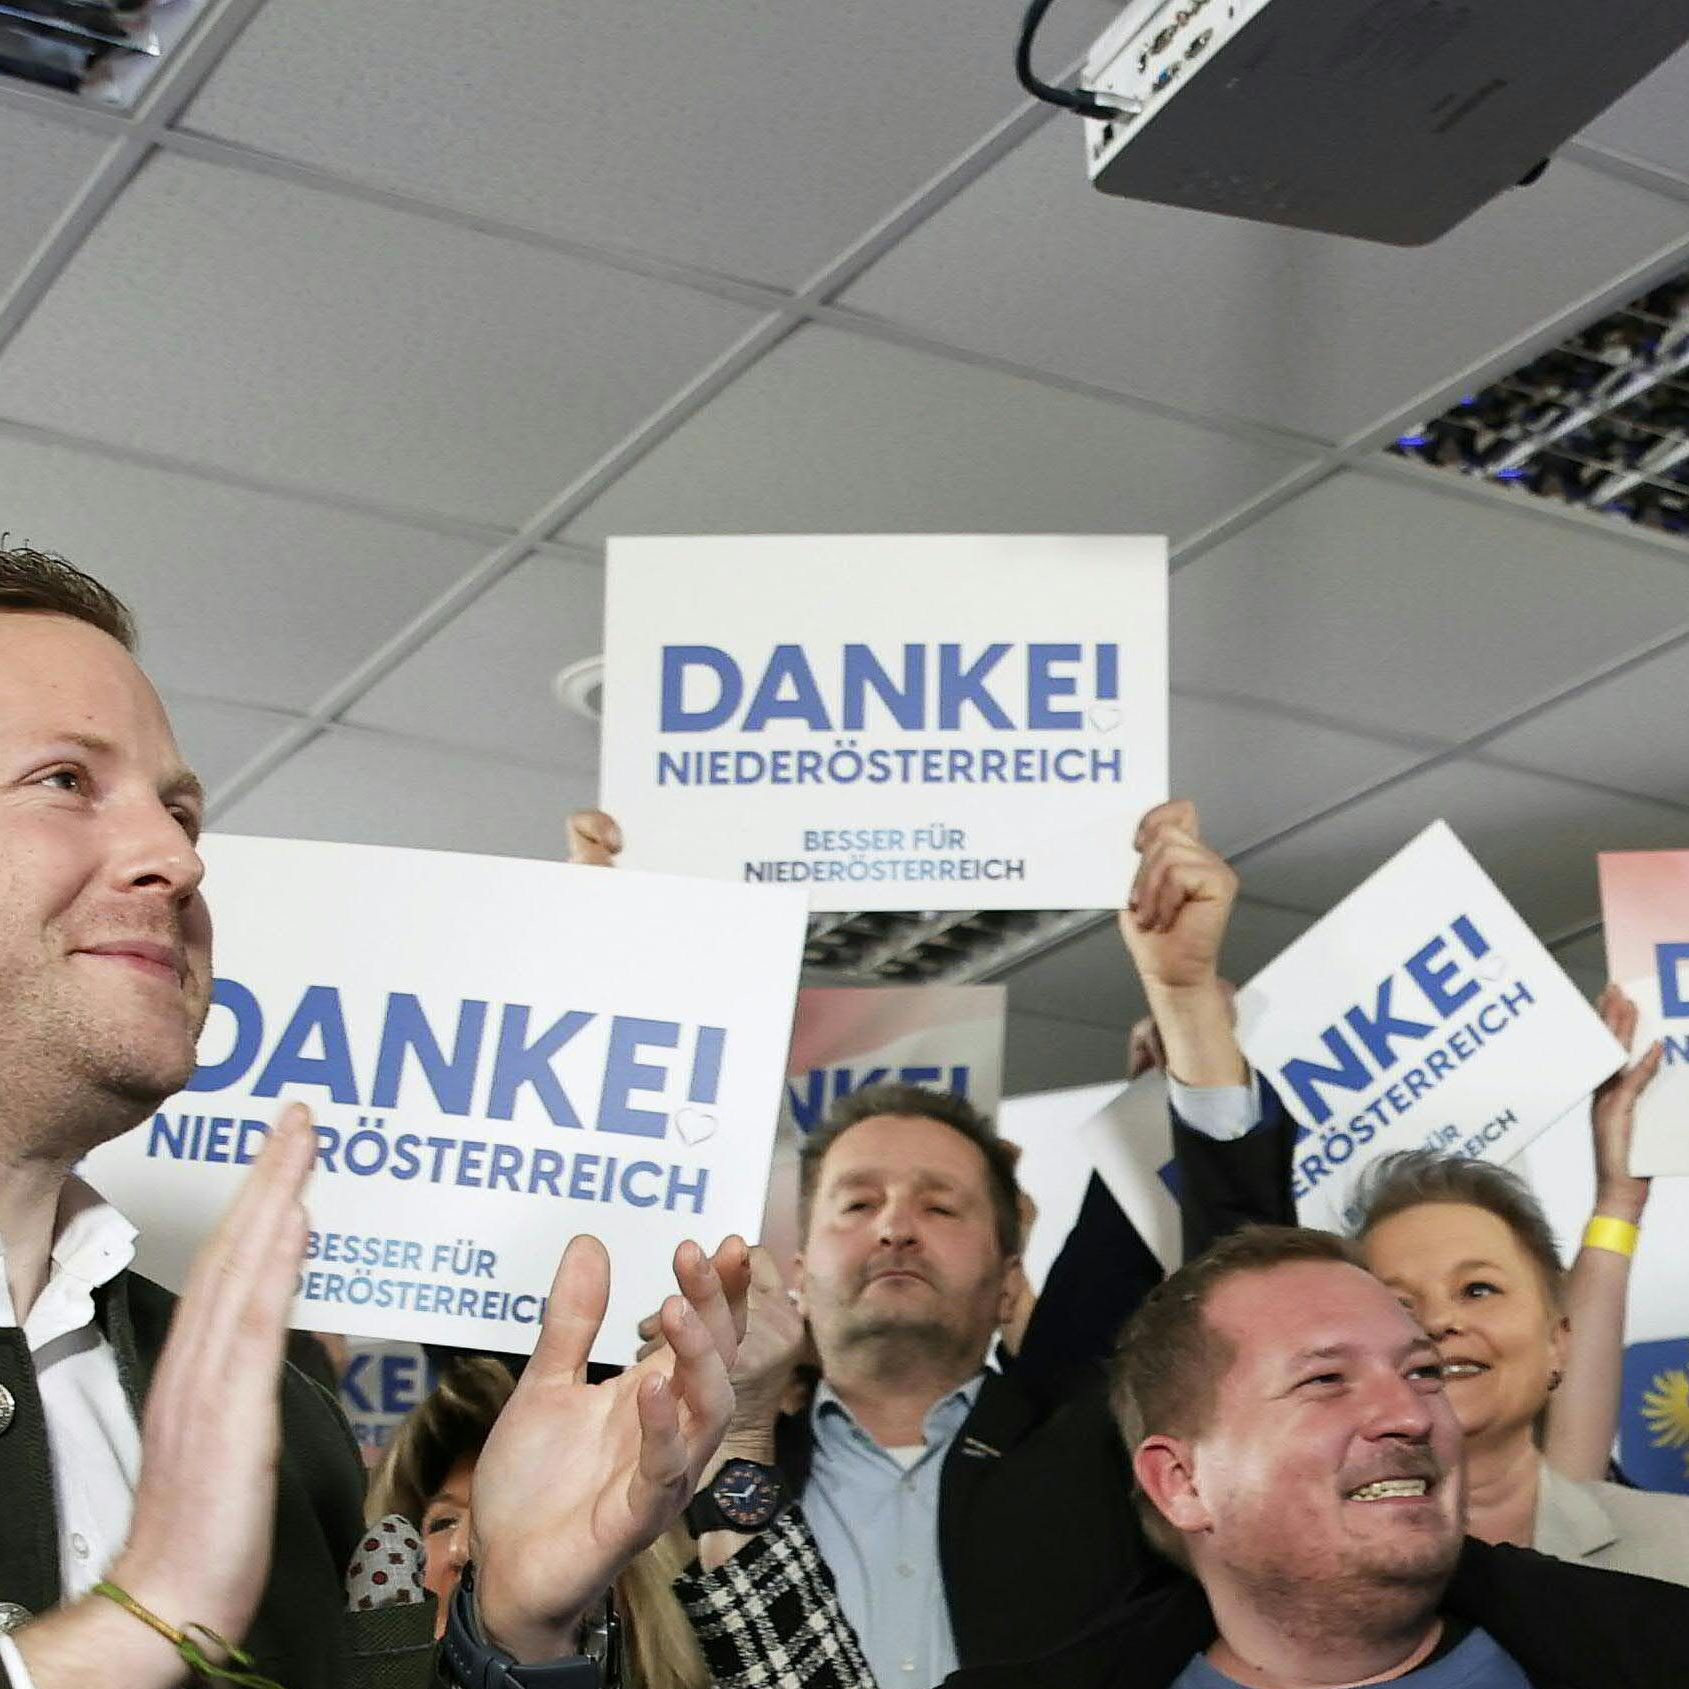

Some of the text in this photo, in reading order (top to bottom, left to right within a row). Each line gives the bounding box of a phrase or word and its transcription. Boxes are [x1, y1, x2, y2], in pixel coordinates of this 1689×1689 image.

[659, 643, 1122, 733] DANKE!
[656, 738, 1122, 787] NIEDERÖSTERREICH
[803, 823, 966, 852] BESSER FÜR
[744, 854, 1026, 885] NIEDERÖSTERREICH
[1281, 914, 1491, 1142] NKE!
[184, 977, 727, 1143] DANKE!
[146, 1112, 710, 1214] NIEDRÖSTERREICH
[303, 1230, 496, 1279] BESSER FÜR
[297, 1268, 548, 1326] ERÖSTERREIC
